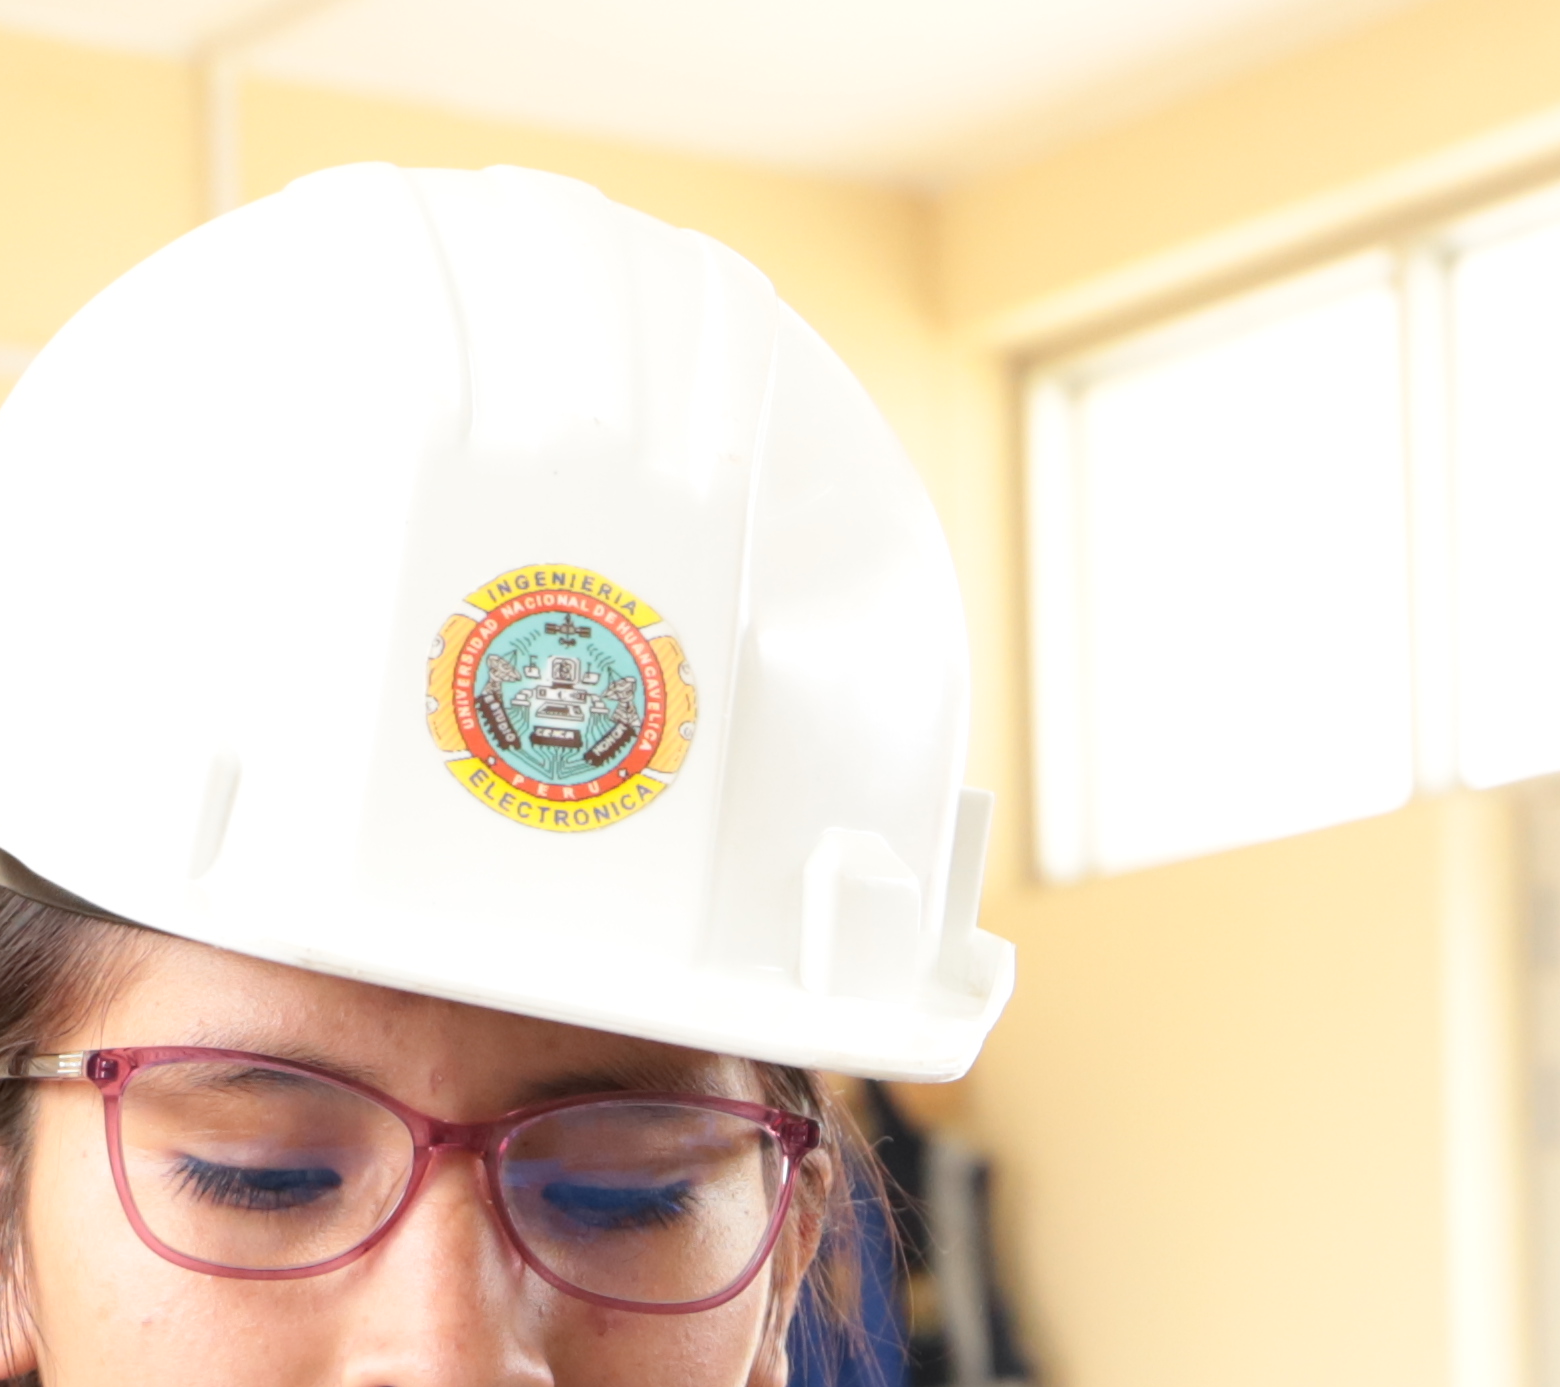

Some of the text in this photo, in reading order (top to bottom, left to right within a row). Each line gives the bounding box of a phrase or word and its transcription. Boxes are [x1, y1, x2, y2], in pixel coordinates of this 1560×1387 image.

[487, 571, 637, 616] INGENIERIA
[455, 594, 662, 751] UNIVERSIDAD NACIONAL DE HUANCAVELICA
[468, 768, 654, 827] ELECTRONICA
[511, 773, 601, 800] PERU
